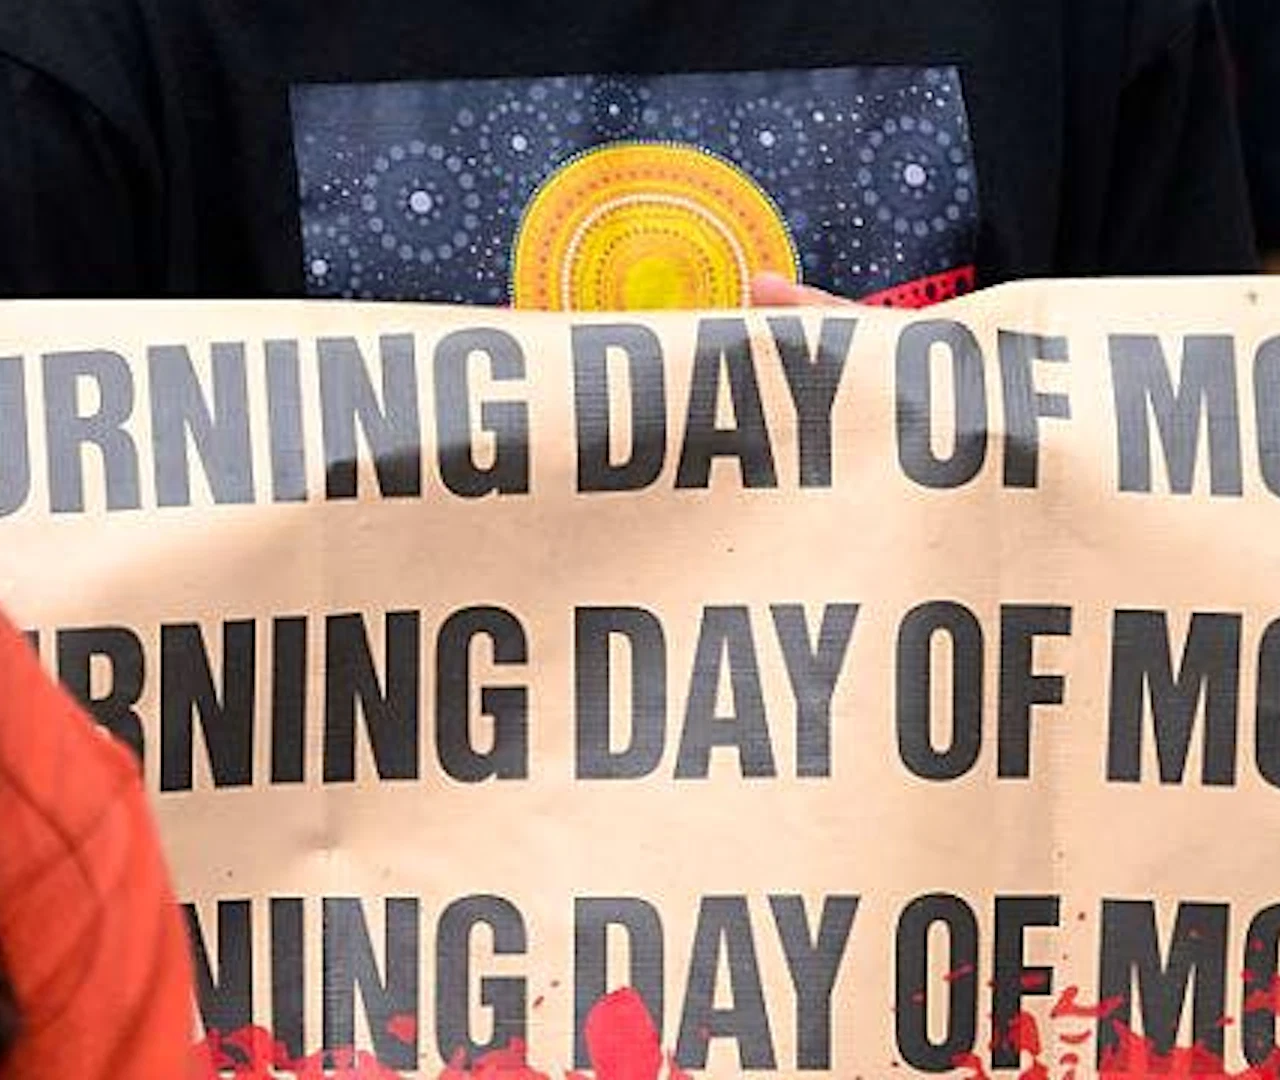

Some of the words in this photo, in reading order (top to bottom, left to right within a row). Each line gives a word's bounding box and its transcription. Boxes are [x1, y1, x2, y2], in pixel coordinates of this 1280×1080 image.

[572, 322, 858, 492] DAY
[894, 319, 1072, 490] OF
[22, 606, 529, 793] RNING
[573, 603, 860, 780] DAY
[895, 600, 1072, 781] OF
[572, 894, 860, 1072] DAY
[894, 892, 1062, 1074] OF
